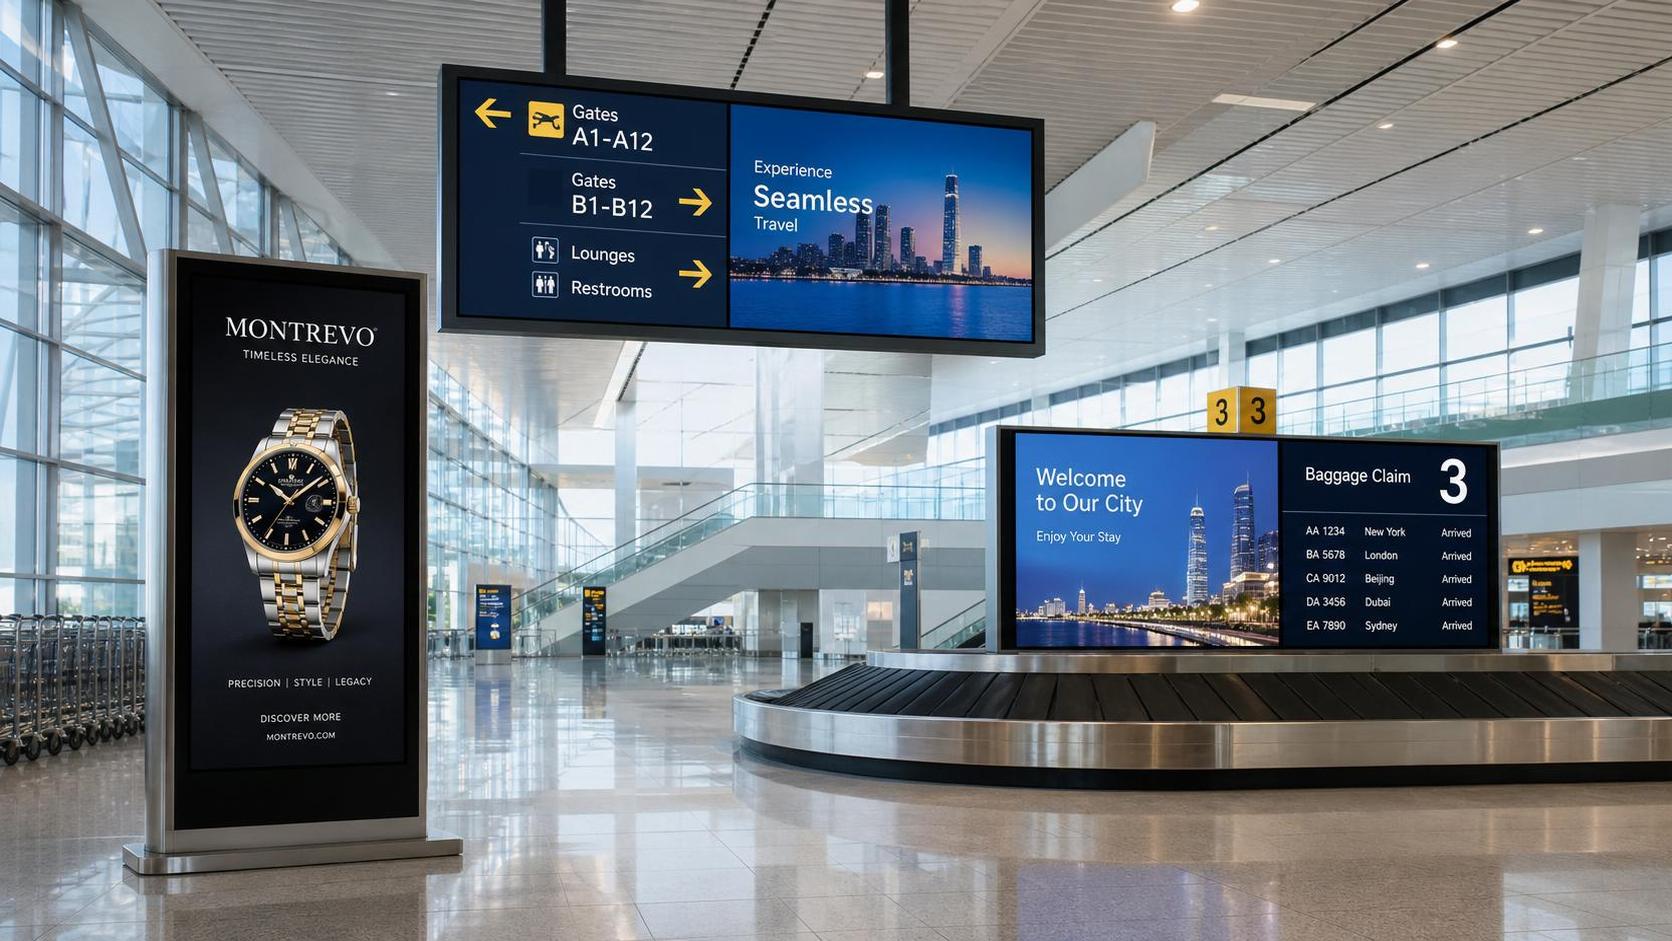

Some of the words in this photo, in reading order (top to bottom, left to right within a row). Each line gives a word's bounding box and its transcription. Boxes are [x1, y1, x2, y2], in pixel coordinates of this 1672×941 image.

[572, 104, 618, 122] Gates
[572, 127, 653, 151] A1-A12
[754, 160, 833, 179] Experience
[571, 172, 616, 189] Gates
[572, 195, 653, 219] B1-B12
[753, 184, 873, 215] Seamless
[754, 216, 798, 232] Travel
[571, 245, 635, 265] Lounges
[571, 280, 652, 298] Restrooms
[242, 349, 297, 363] TIMELESS
[301, 353, 359, 367] ELEGANCE
[1215, 398, 1228, 426] 3
[1250, 396, 1266, 425] 3
[1036, 467, 1126, 488] Welcome
[1305, 466, 1368, 486] Baggage
[1372, 468, 1411, 483] Claim
[1439, 458, 1468, 505] 3
[1035, 494, 1057, 511] to
[1062, 493, 1100, 512] Our
[1105, 494, 1143, 517] City
[1036, 530, 1067, 544] Enjoy
[1069, 531, 1095, 542] Your
[1097, 531, 1122, 545] Stay
[1305, 526, 1320, 536] AA
[1322, 526, 1345, 536] 1234
[1364, 527, 1385, 537] New
[1385, 527, 1406, 537] York
[1441, 528, 1472, 538] Arrived
[1306, 550, 1320, 559] BA
[1322, 550, 1346, 560] 5678
[1364, 550, 1398, 560] London
[1441, 551, 1472, 562] Arrived
[1306, 573, 1320, 583] CA
[1322, 573, 1346, 584] 9012
[1365, 574, 1395, 586] Beijing
[1441, 574, 1472, 585] Arrived
[1306, 597, 1320, 607] DA
[1322, 597, 1346, 607] 3456
[1365, 597, 1391, 607] Dubai
[1442, 597, 1473, 607] Arrived
[1306, 620, 1320, 630] EA
[1322, 620, 1347, 631] 7890
[1365, 620, 1398, 632] Sydney
[1442, 621, 1473, 631] Arrived
[228, 679, 281, 688] PRECISION
[294, 678, 323, 687] STYLE
[335, 677, 372, 686] LEGACY
[260, 713, 310, 723] DISCOVER
[313, 712, 341, 722] MORE
[266, 731, 336, 741] MONTREVO.COM
